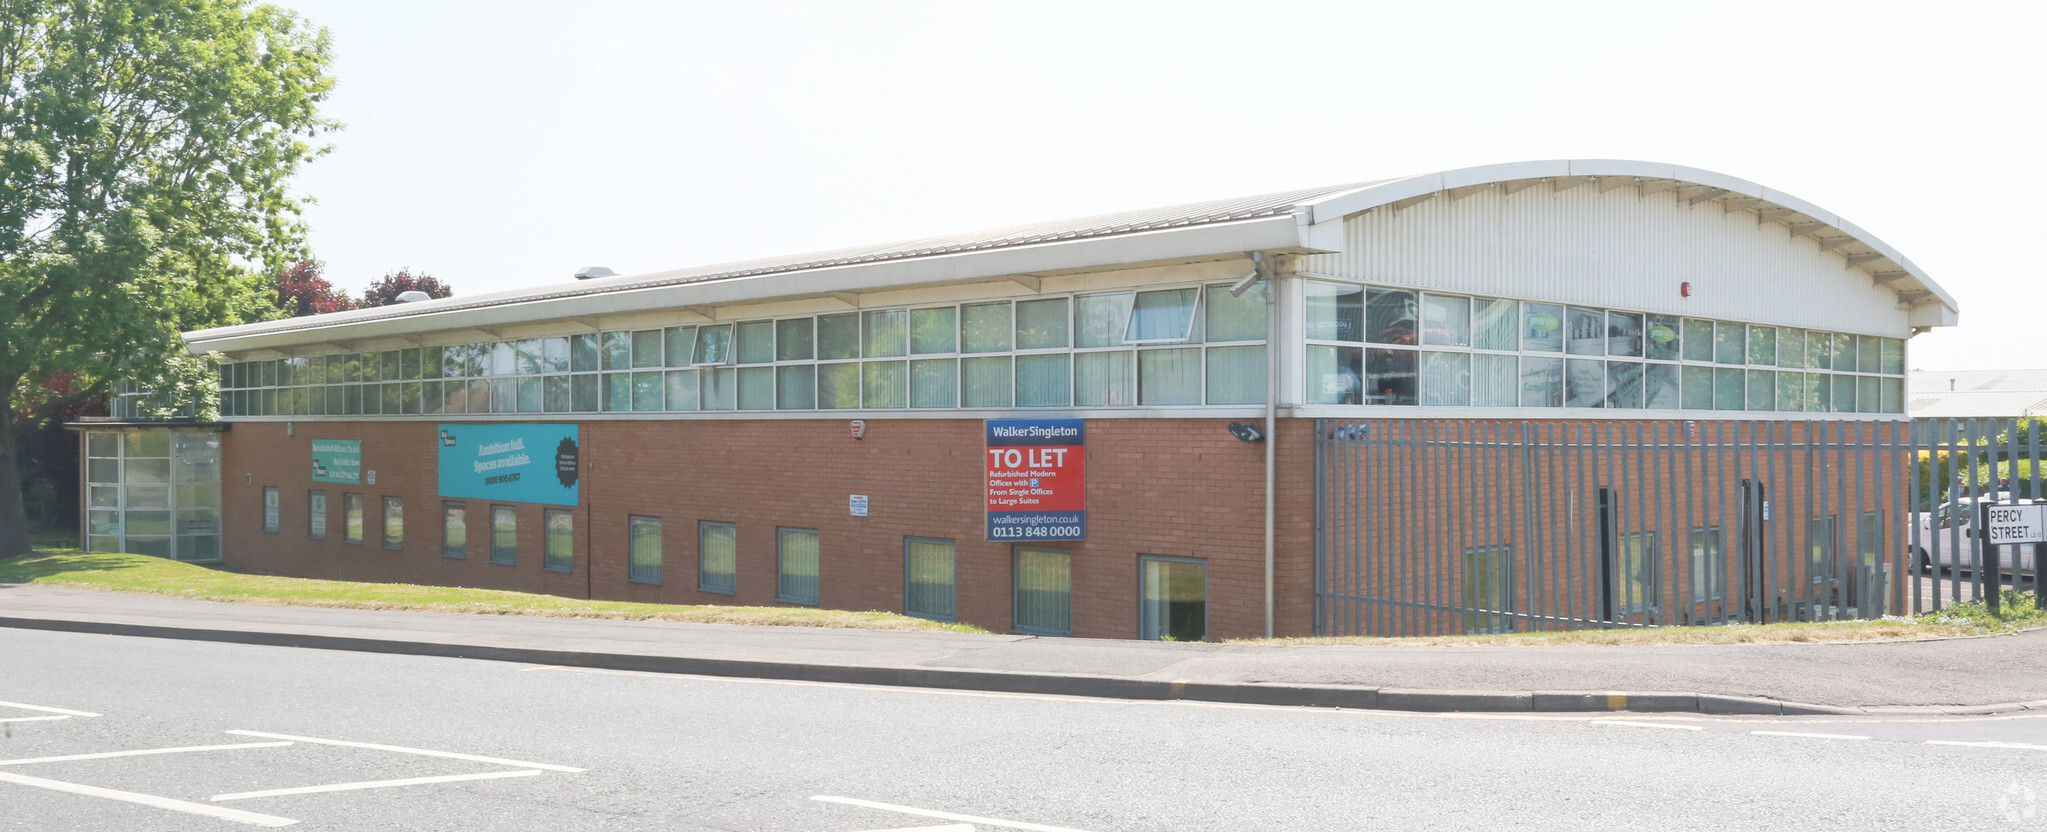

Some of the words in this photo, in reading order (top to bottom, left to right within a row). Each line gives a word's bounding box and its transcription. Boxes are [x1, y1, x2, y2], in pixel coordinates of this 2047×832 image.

[478, 441, 510, 456] Ambition
[989, 449, 1022, 468] TO
[1029, 449, 1068, 468] LET
[474, 460, 497, 474] Spaces
[993, 515, 1079, 526] walkersingleton.co.uk
[1990, 510, 2023, 523] PERCY
[993, 527, 1022, 537] 0113
[1025, 527, 1047, 537] 848
[1050, 526, 1080, 536] 0000
[1991, 526, 2029, 539] STREET
